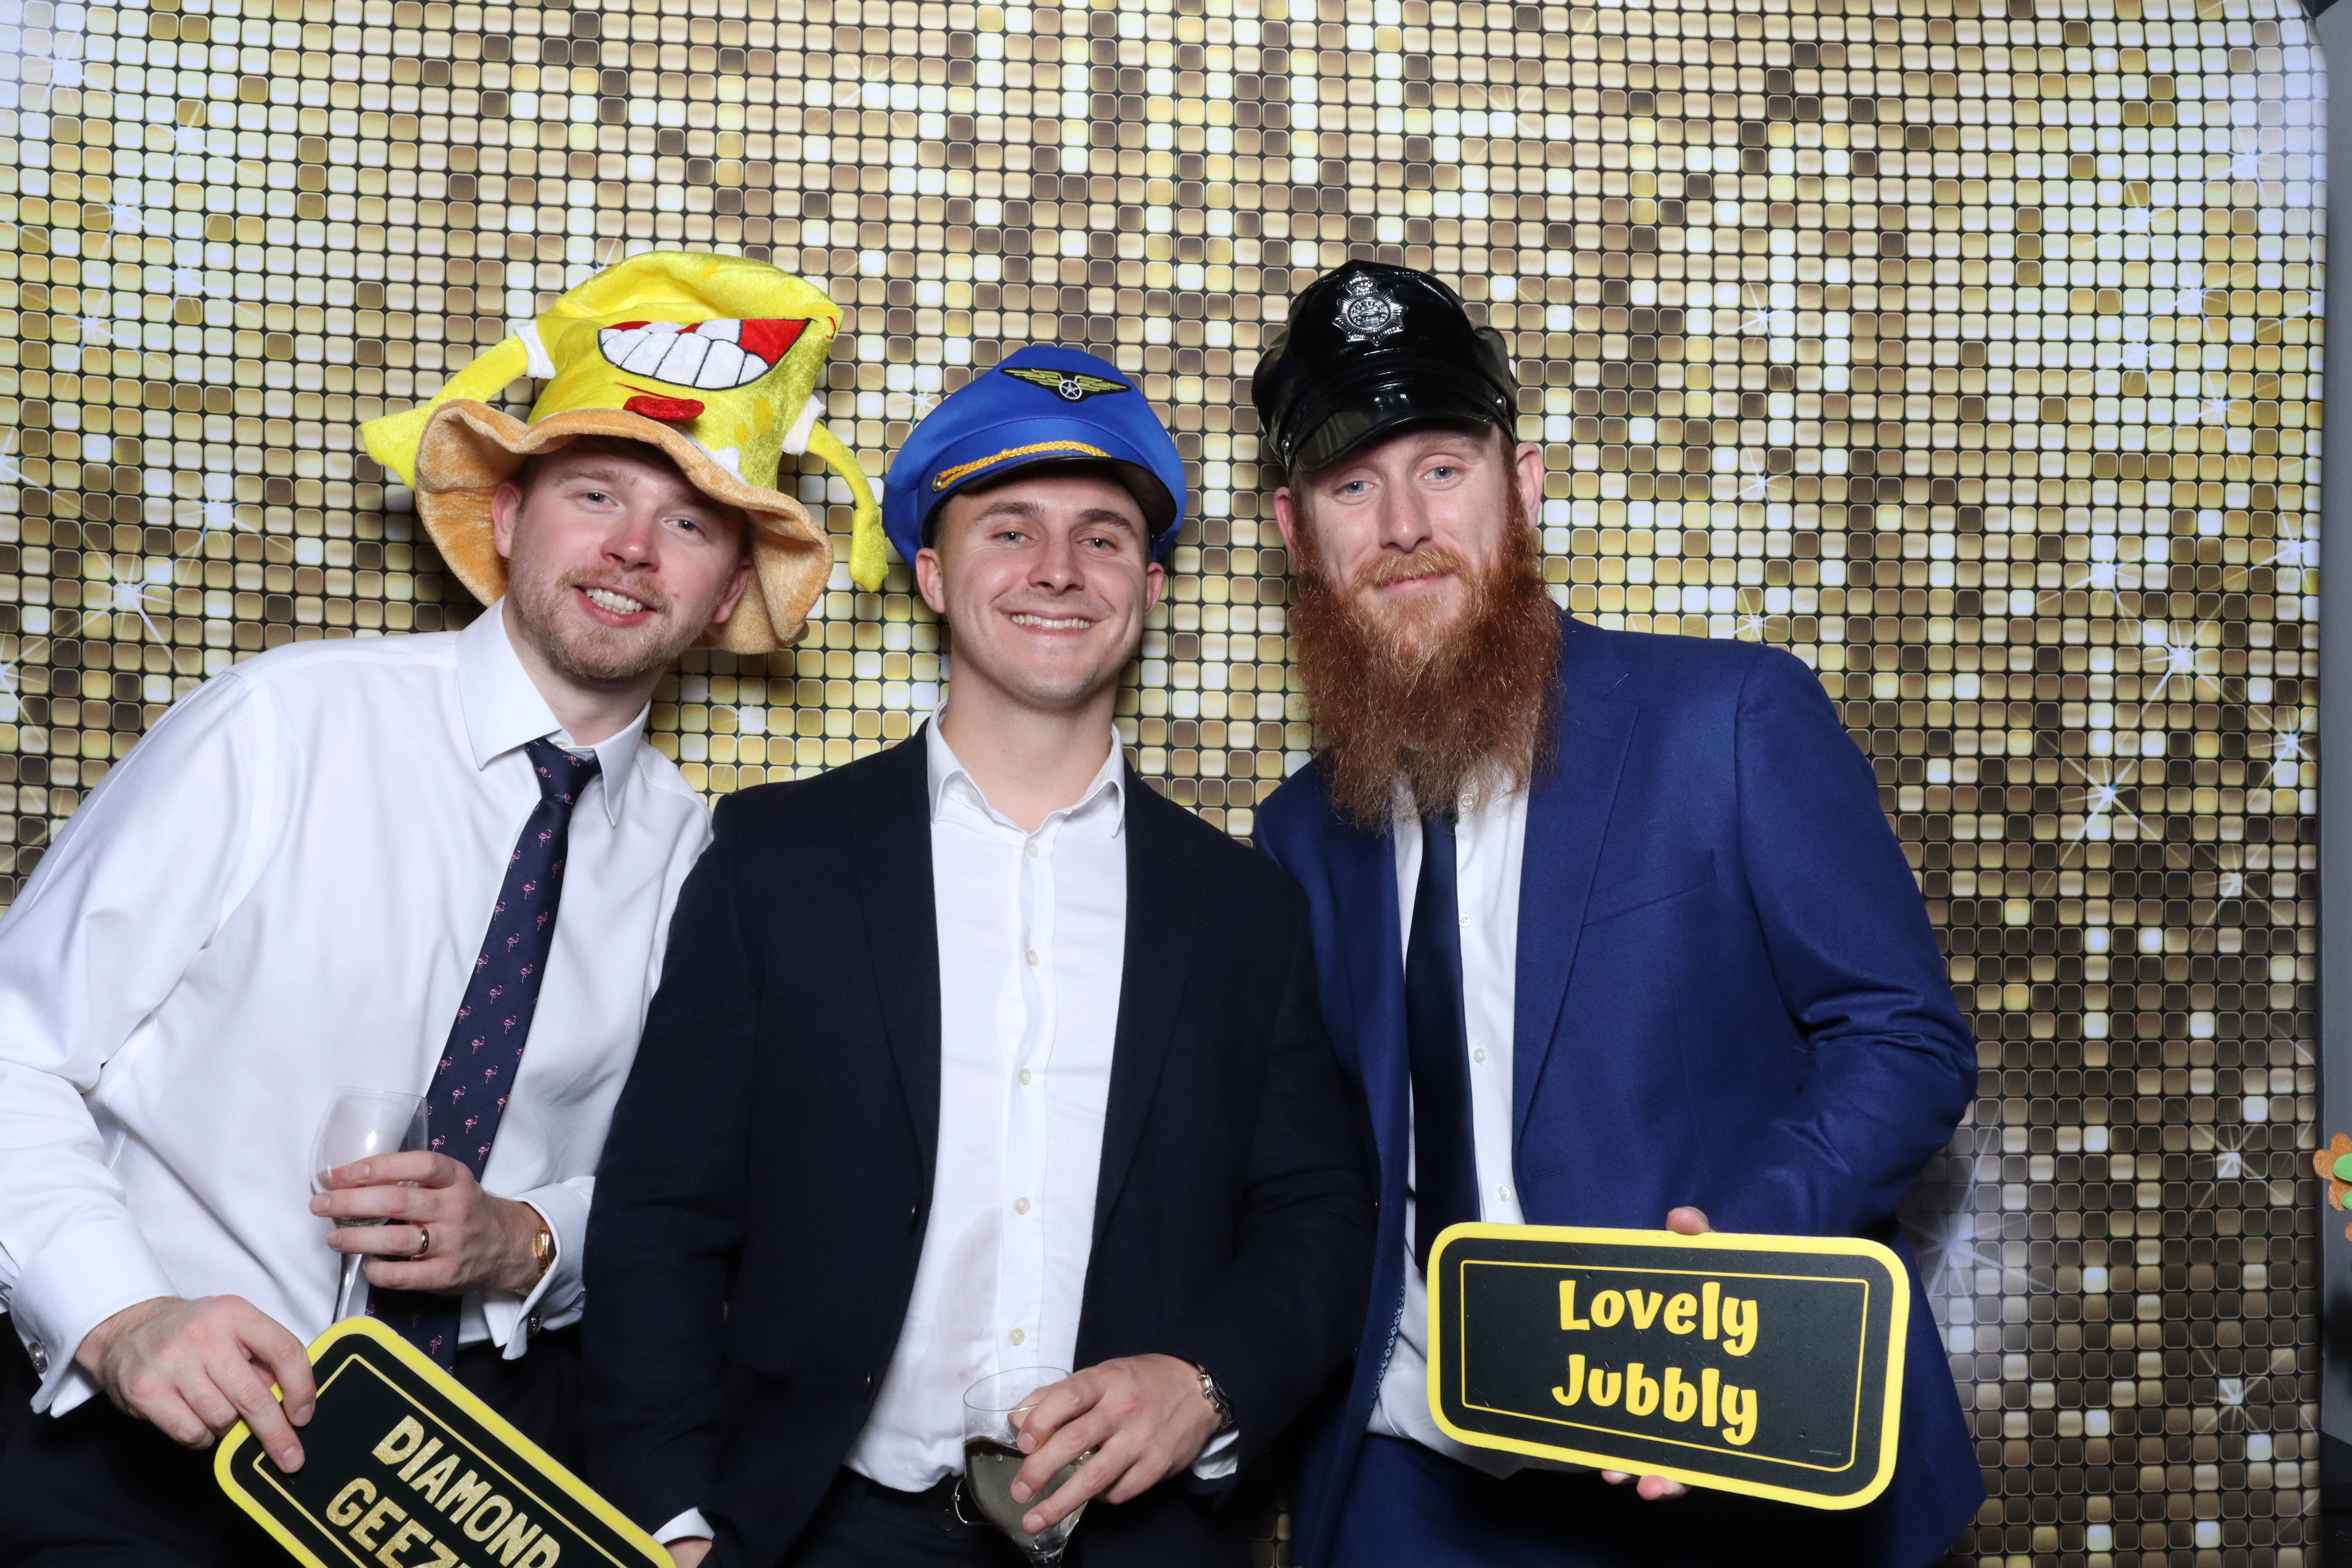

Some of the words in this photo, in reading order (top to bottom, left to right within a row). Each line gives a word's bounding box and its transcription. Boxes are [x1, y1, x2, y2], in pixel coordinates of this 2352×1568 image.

[1559, 1279, 1758, 1357] Lovely
[1552, 1354, 1758, 1446] Jubbly
[326, 1477, 472, 1568] GEEZ
[372, 1415, 561, 1568] DIAMOND
